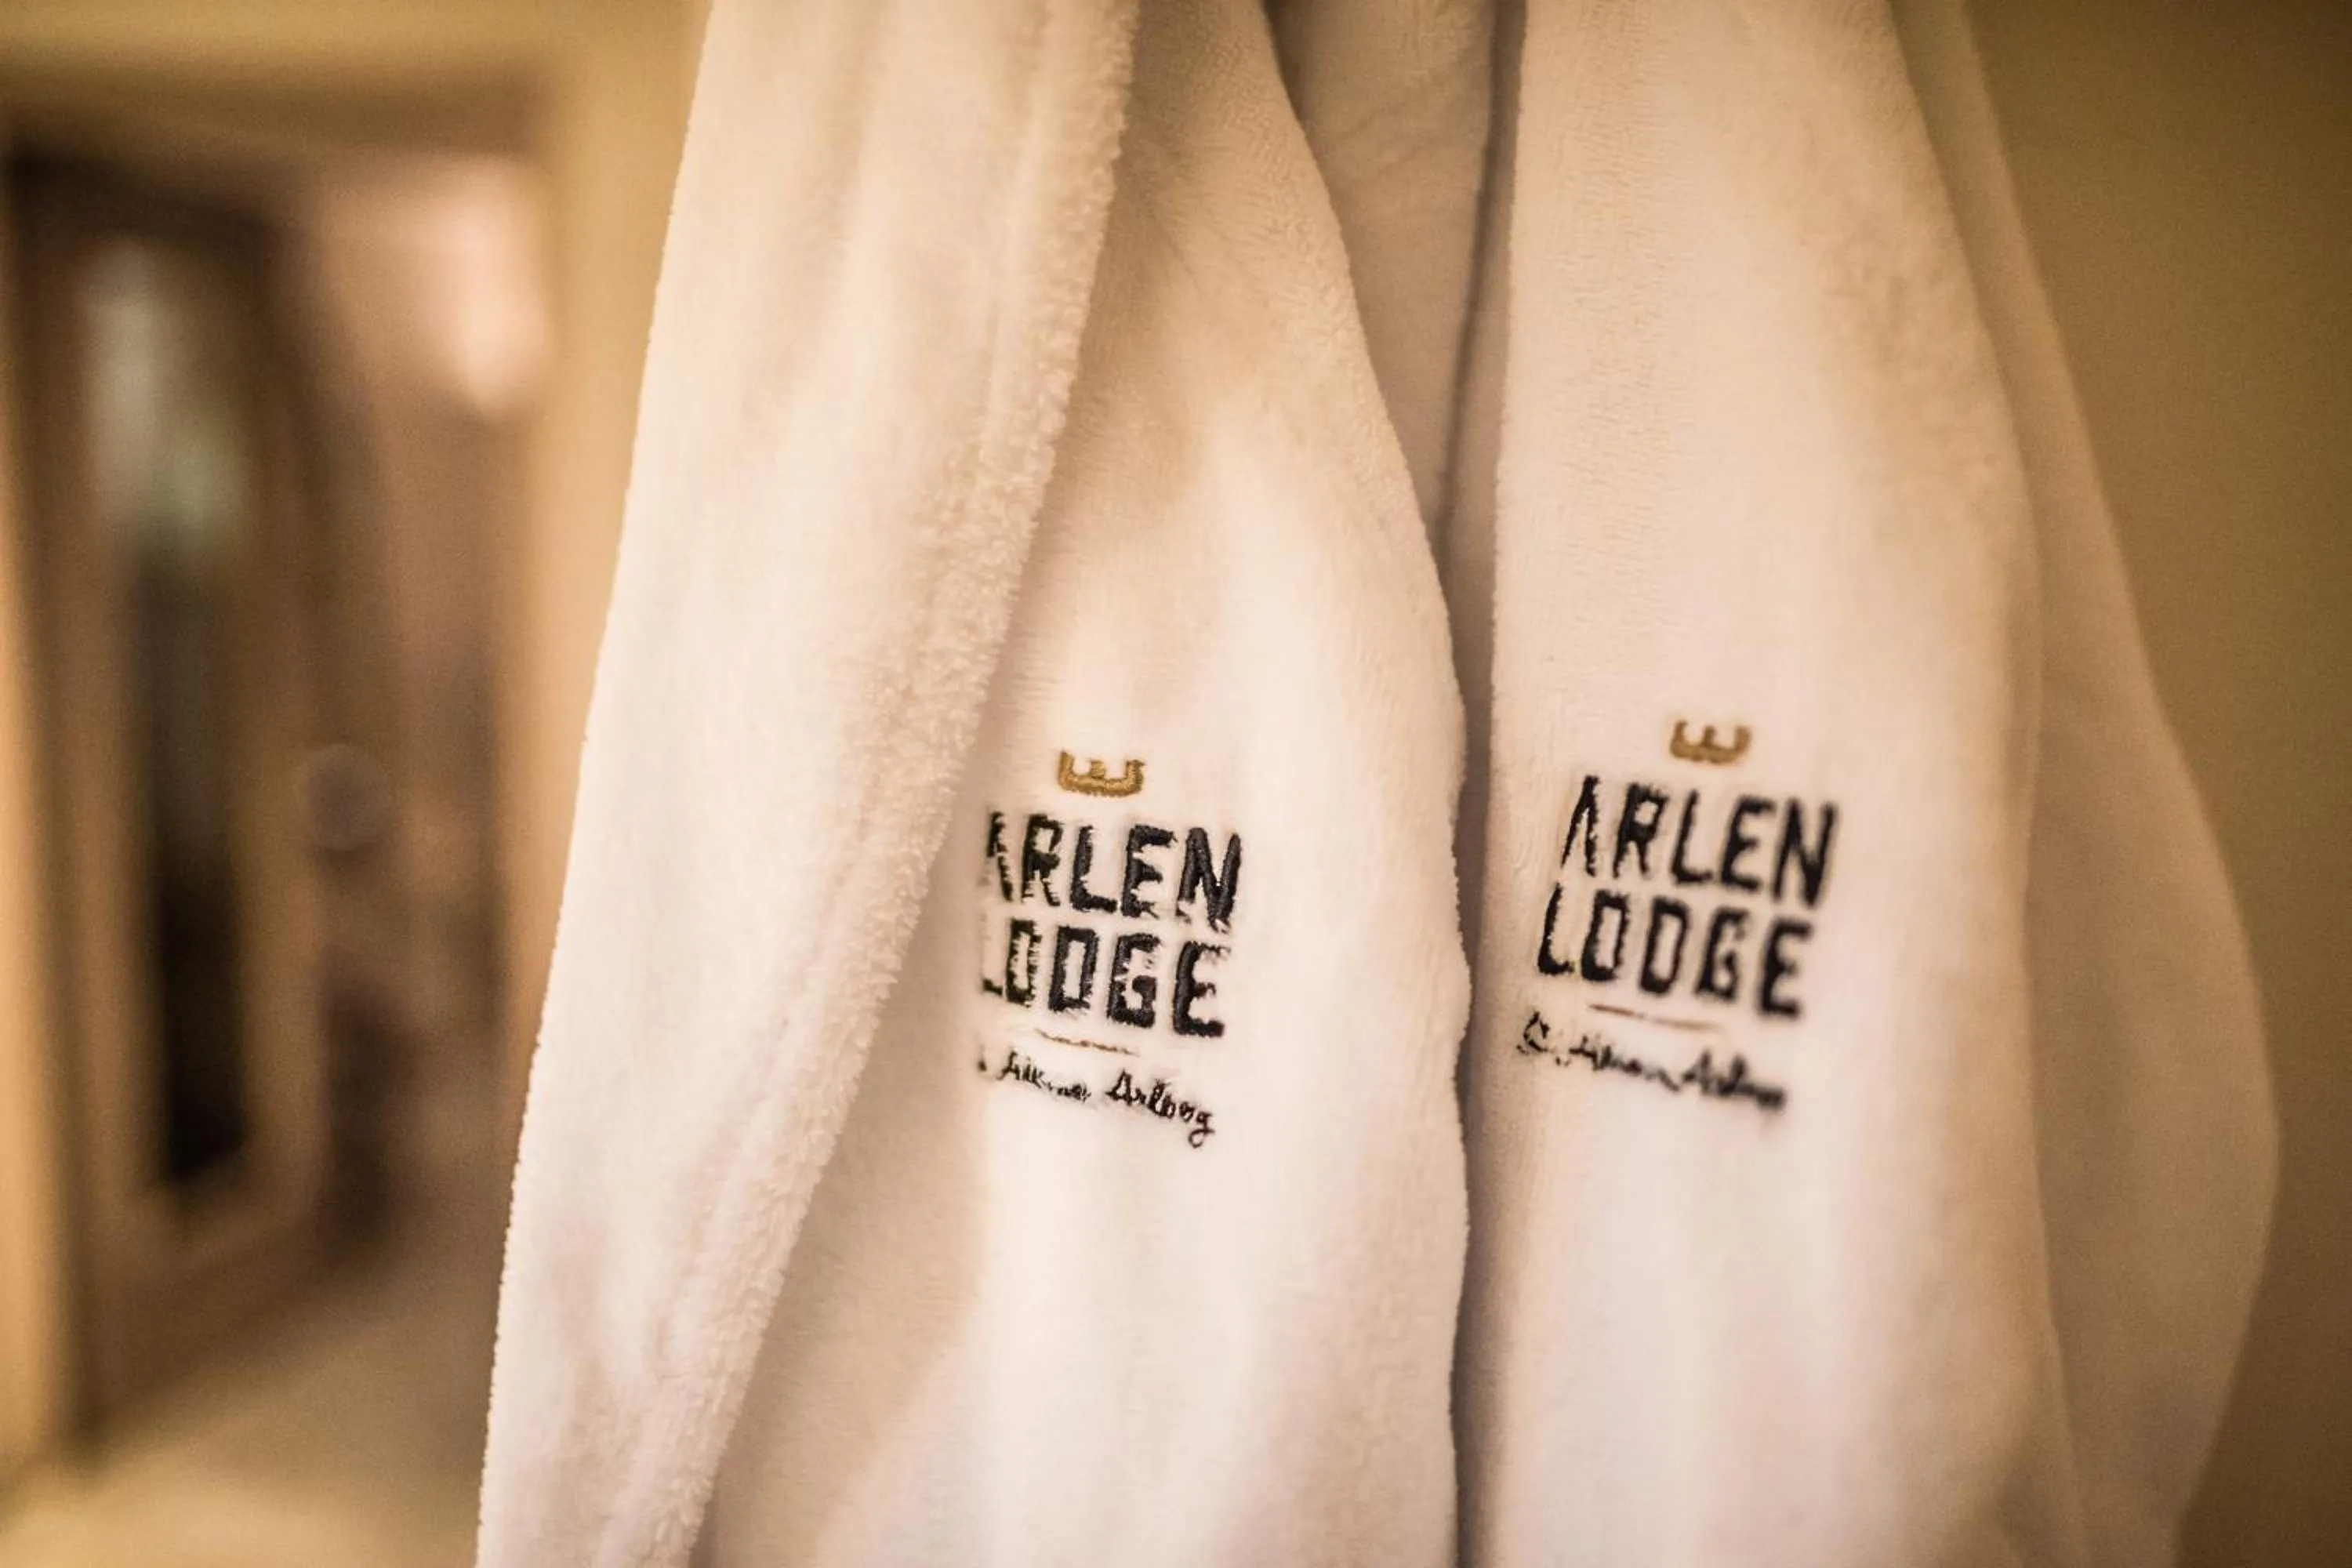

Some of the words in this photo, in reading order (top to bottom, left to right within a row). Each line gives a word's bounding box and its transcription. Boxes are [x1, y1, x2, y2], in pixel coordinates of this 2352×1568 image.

[984, 811, 1241, 935] ARLEN
[1560, 775, 1838, 911] ARLEN
[1537, 882, 1813, 1019] LODGE
